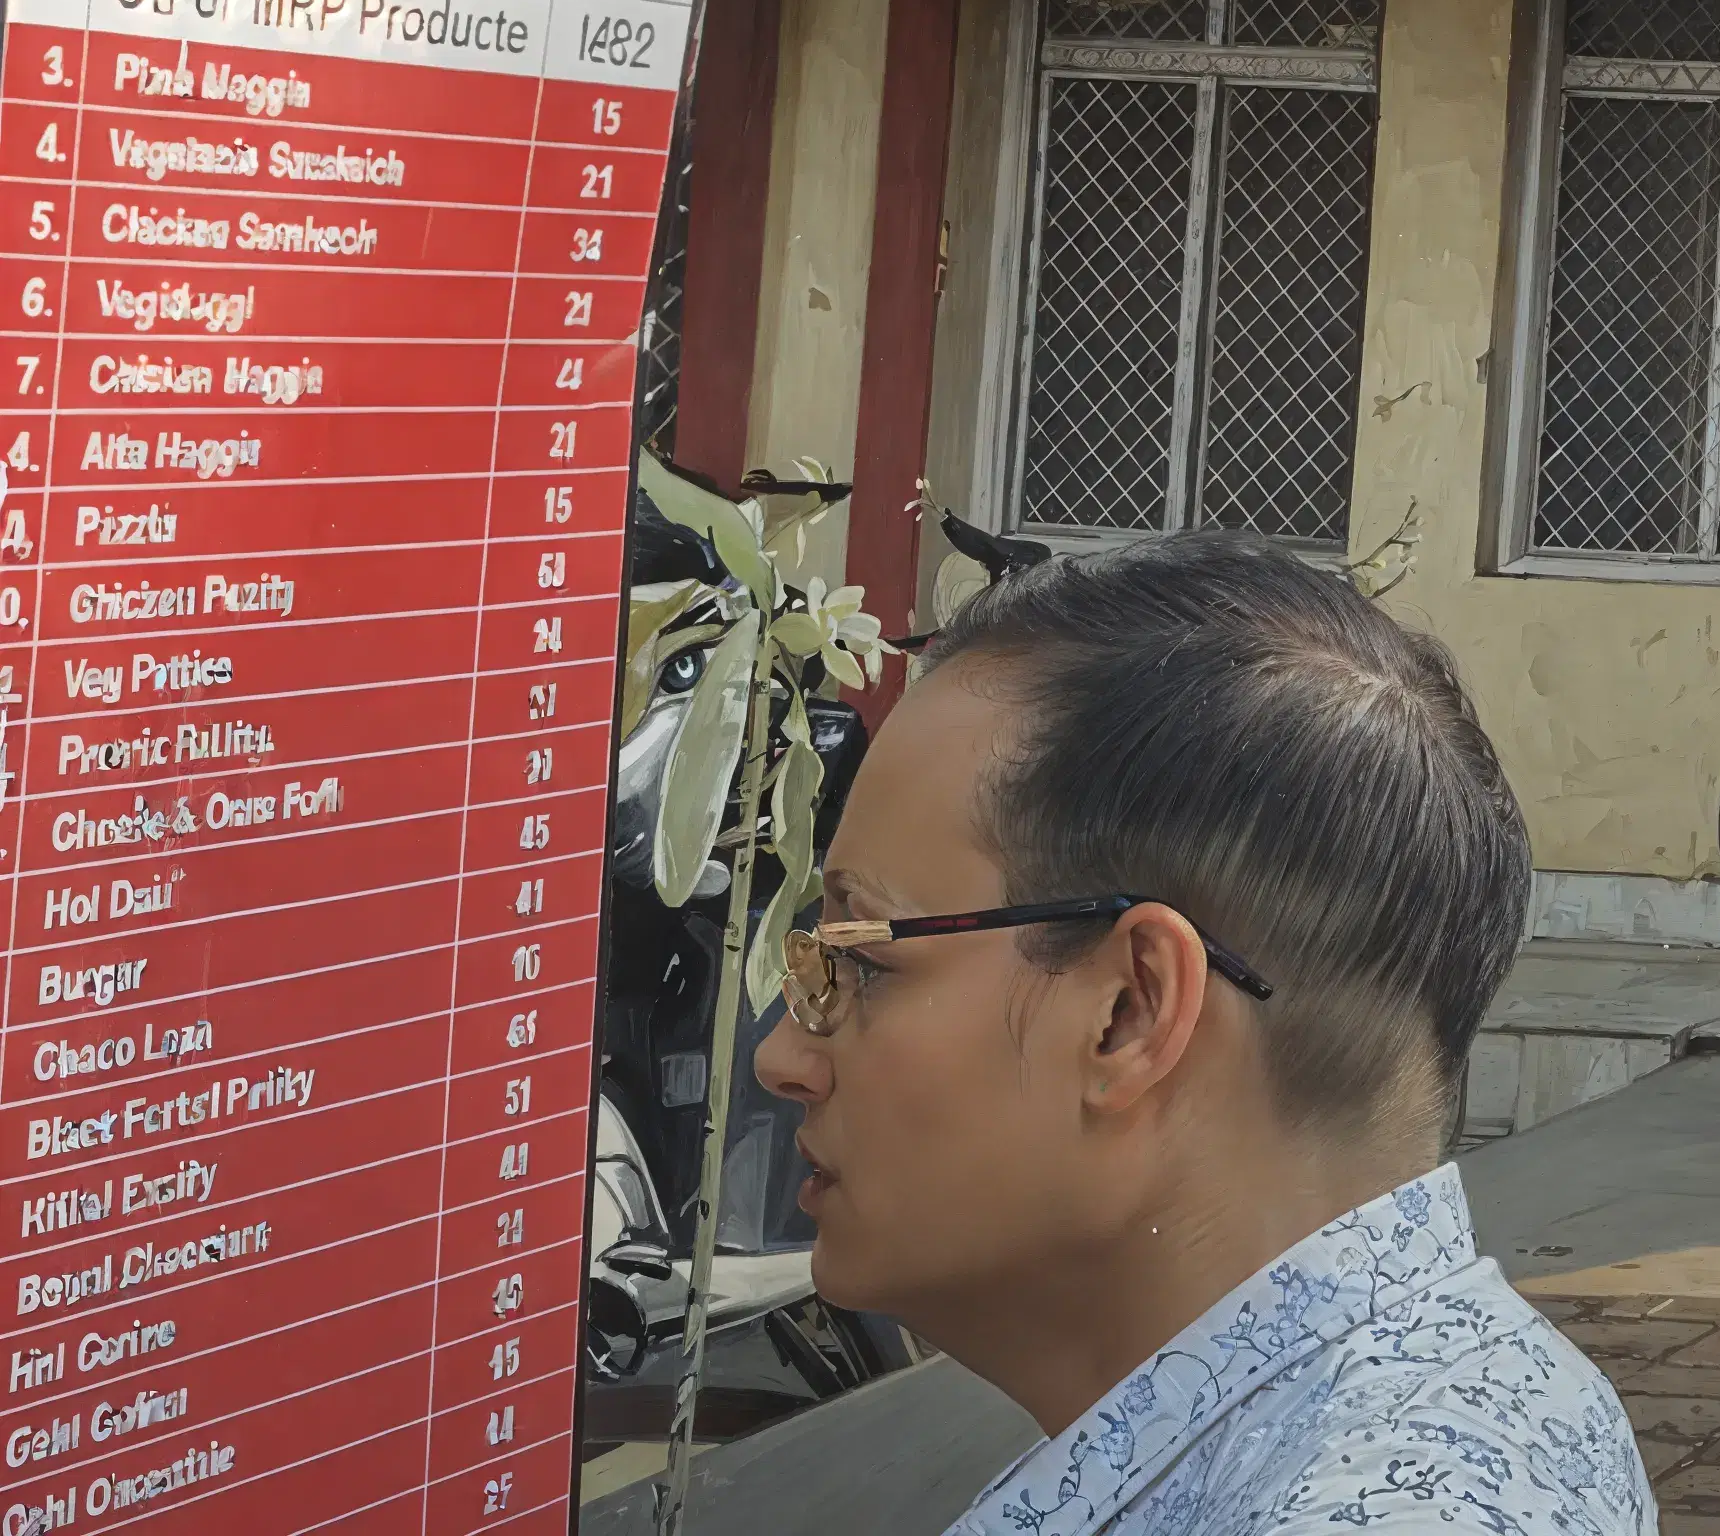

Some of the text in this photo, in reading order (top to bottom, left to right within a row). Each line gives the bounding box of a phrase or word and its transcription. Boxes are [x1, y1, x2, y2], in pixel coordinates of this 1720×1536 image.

[41, 46, 73, 87] 3.
[592, 98, 623, 135] 15
[35, 122, 66, 163] 4.
[580, 164, 614, 199] 21
[29, 201, 60, 241] 5.
[21, 276, 53, 317] 6.
[16, 354, 44, 395] 7.
[550, 421, 577, 458] 21
[544, 487, 573, 524] 15
